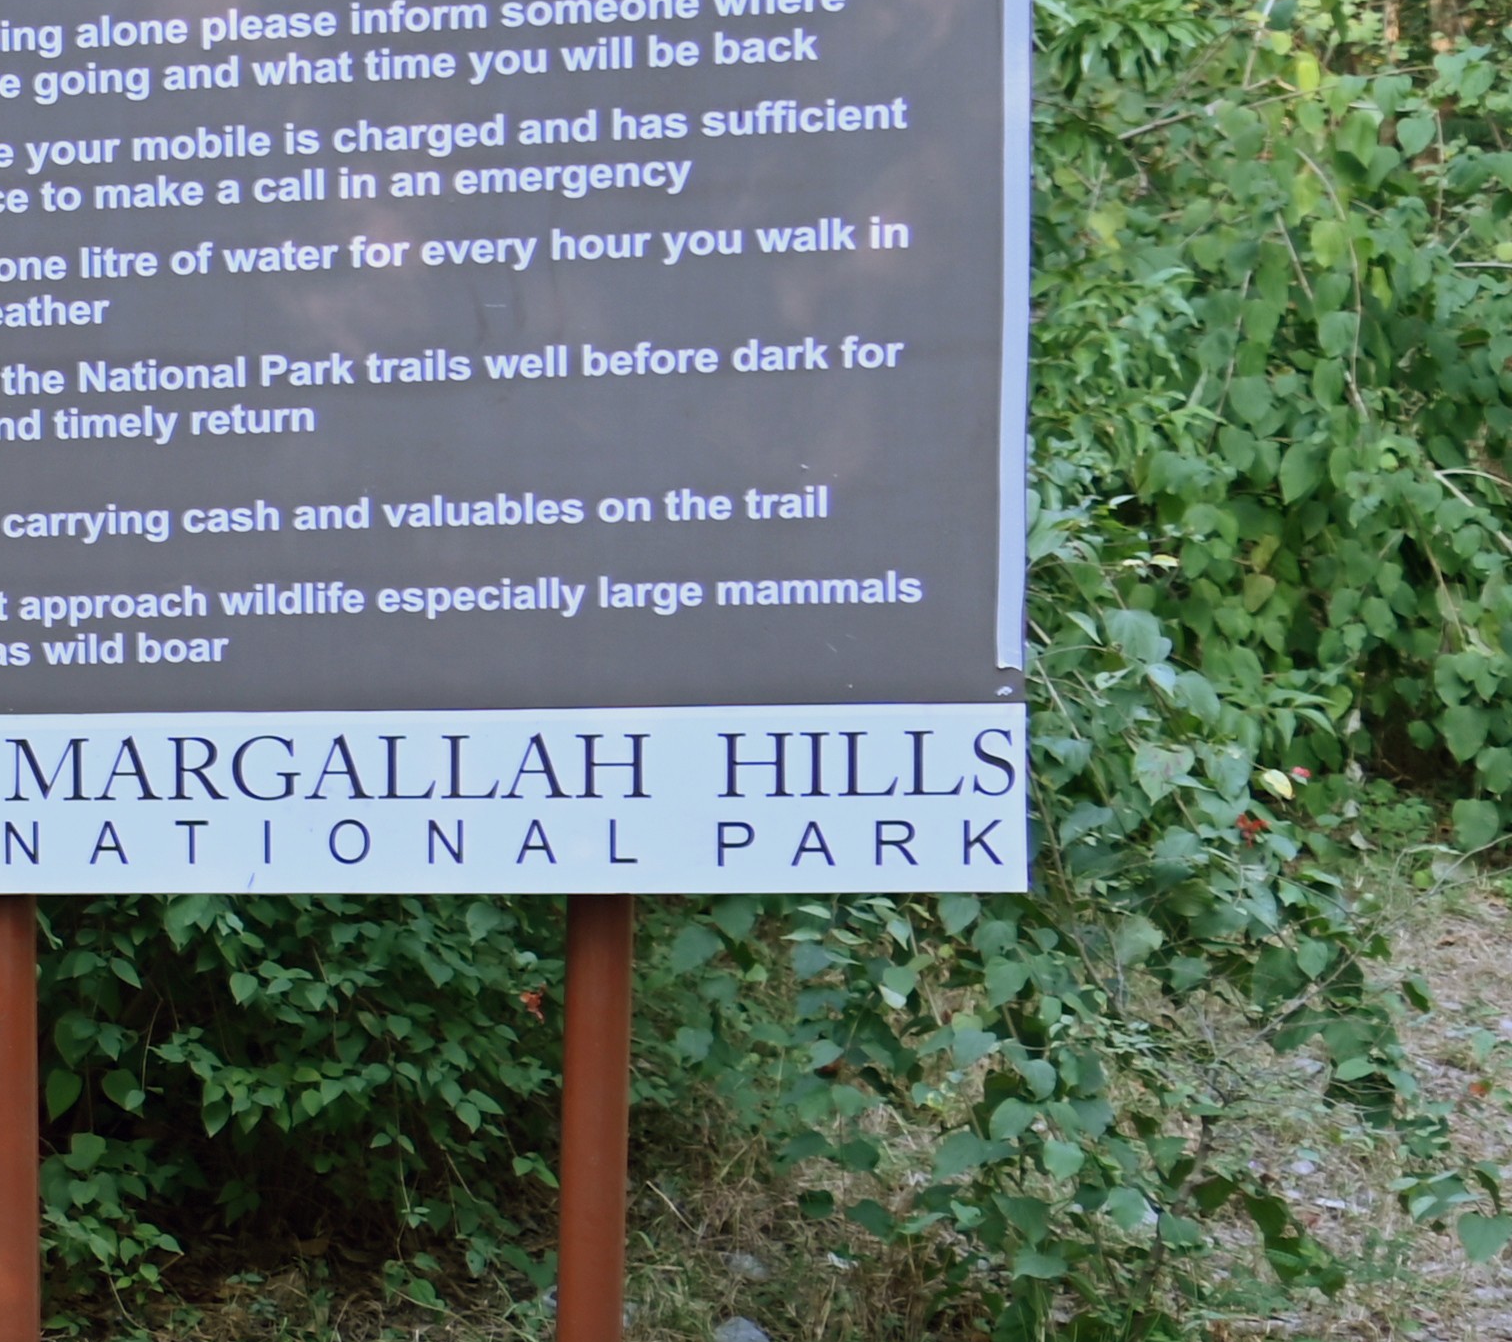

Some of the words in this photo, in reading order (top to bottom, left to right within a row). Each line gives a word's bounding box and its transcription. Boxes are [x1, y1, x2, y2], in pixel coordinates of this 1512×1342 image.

[19, 584, 207, 629] approach
[219, 580, 365, 616] wildlife
[377, 576, 586, 620] especially
[599, 575, 703, 617] large
[717, 569, 923, 607] mammals
[42, 631, 124, 666] wild
[137, 631, 230, 664] boar
[3, 731, 652, 803] MARGALLAH
[716, 726, 1016, 800] HILLS
[4, 818, 638, 865] NATIONAL
[717, 818, 1003, 868] PARK
